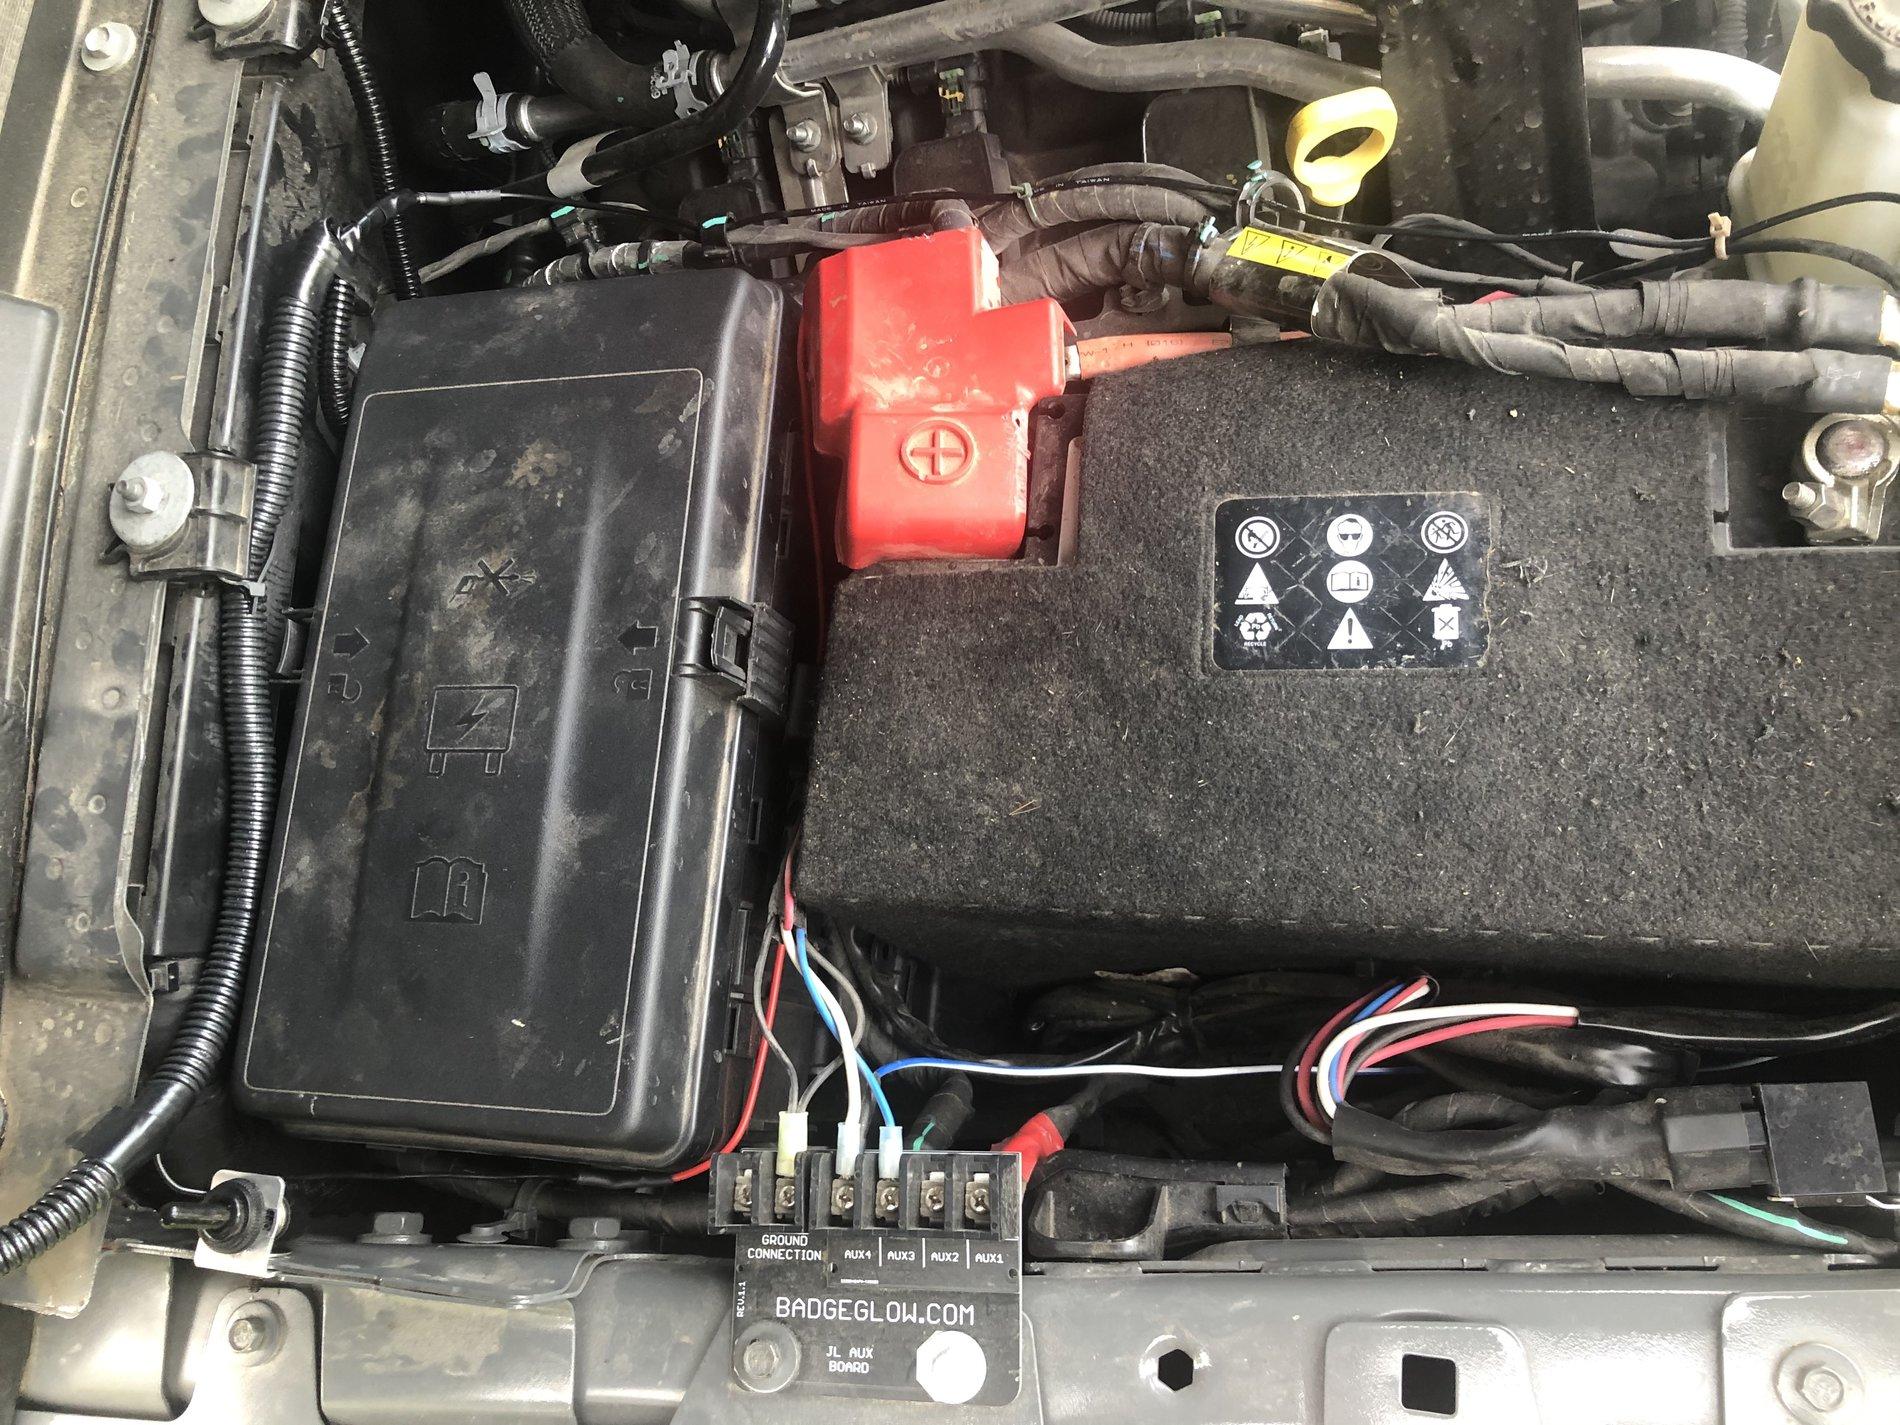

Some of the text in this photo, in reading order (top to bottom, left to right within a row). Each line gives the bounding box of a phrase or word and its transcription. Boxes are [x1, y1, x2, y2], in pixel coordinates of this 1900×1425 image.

[1076, 177, 1110, 185] TAIWAN
[857, 198, 887, 207] TAIWAN
[762, 1234, 808, 1247] GROUND
[747, 1248, 822, 1260] CONNECTION
[844, 1249, 872, 1260] AUX4
[887, 1250, 916, 1261] AUX3
[930, 1251, 960, 1263] AUX2
[974, 1252, 1004, 1264] AUX1
[736, 1281, 747, 1318] REV.1.1
[775, 1296, 975, 1326] BADGEGLOW.COM
[825, 1345, 874, 1359] JL AUX
[828, 1360, 870, 1374] BOARD
